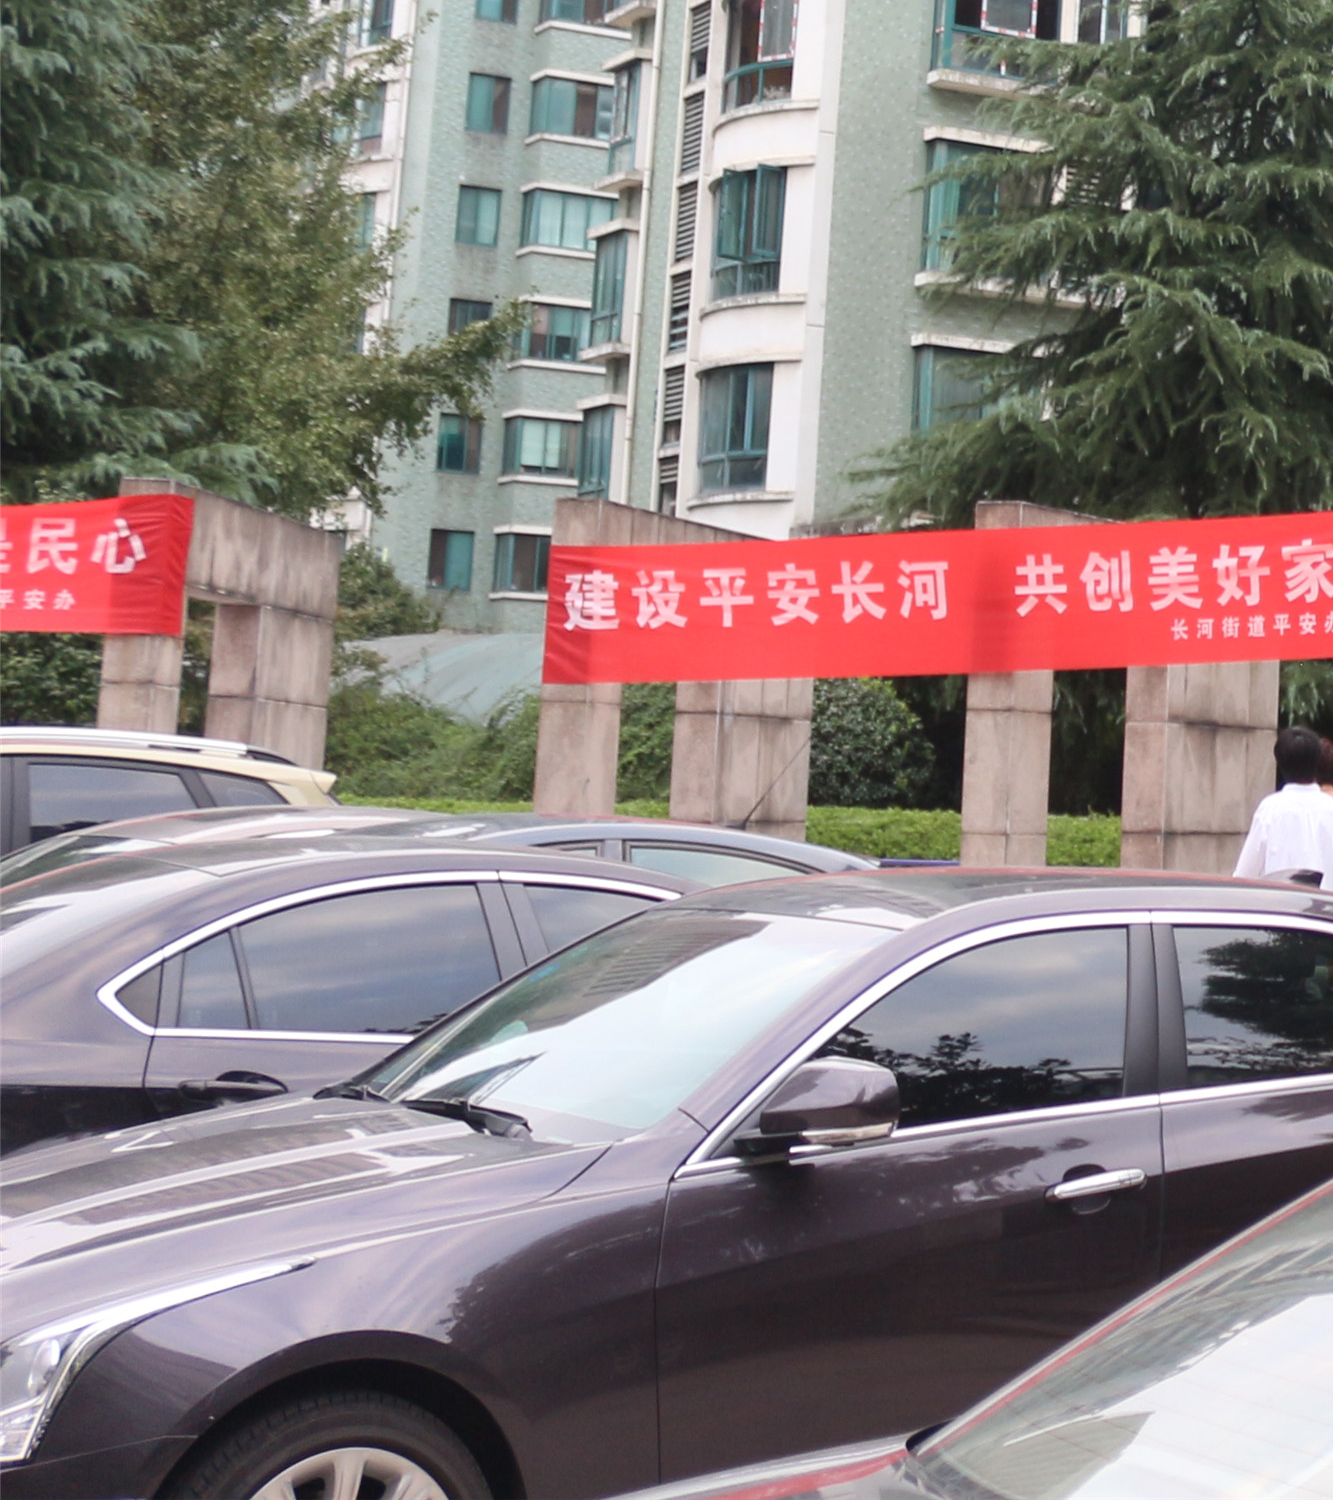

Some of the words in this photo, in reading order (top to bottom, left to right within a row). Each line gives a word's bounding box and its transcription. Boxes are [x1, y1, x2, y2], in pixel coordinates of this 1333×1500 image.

[0, 517, 147, 575] 民心
[564, 560, 949, 631] 建设平安长河
